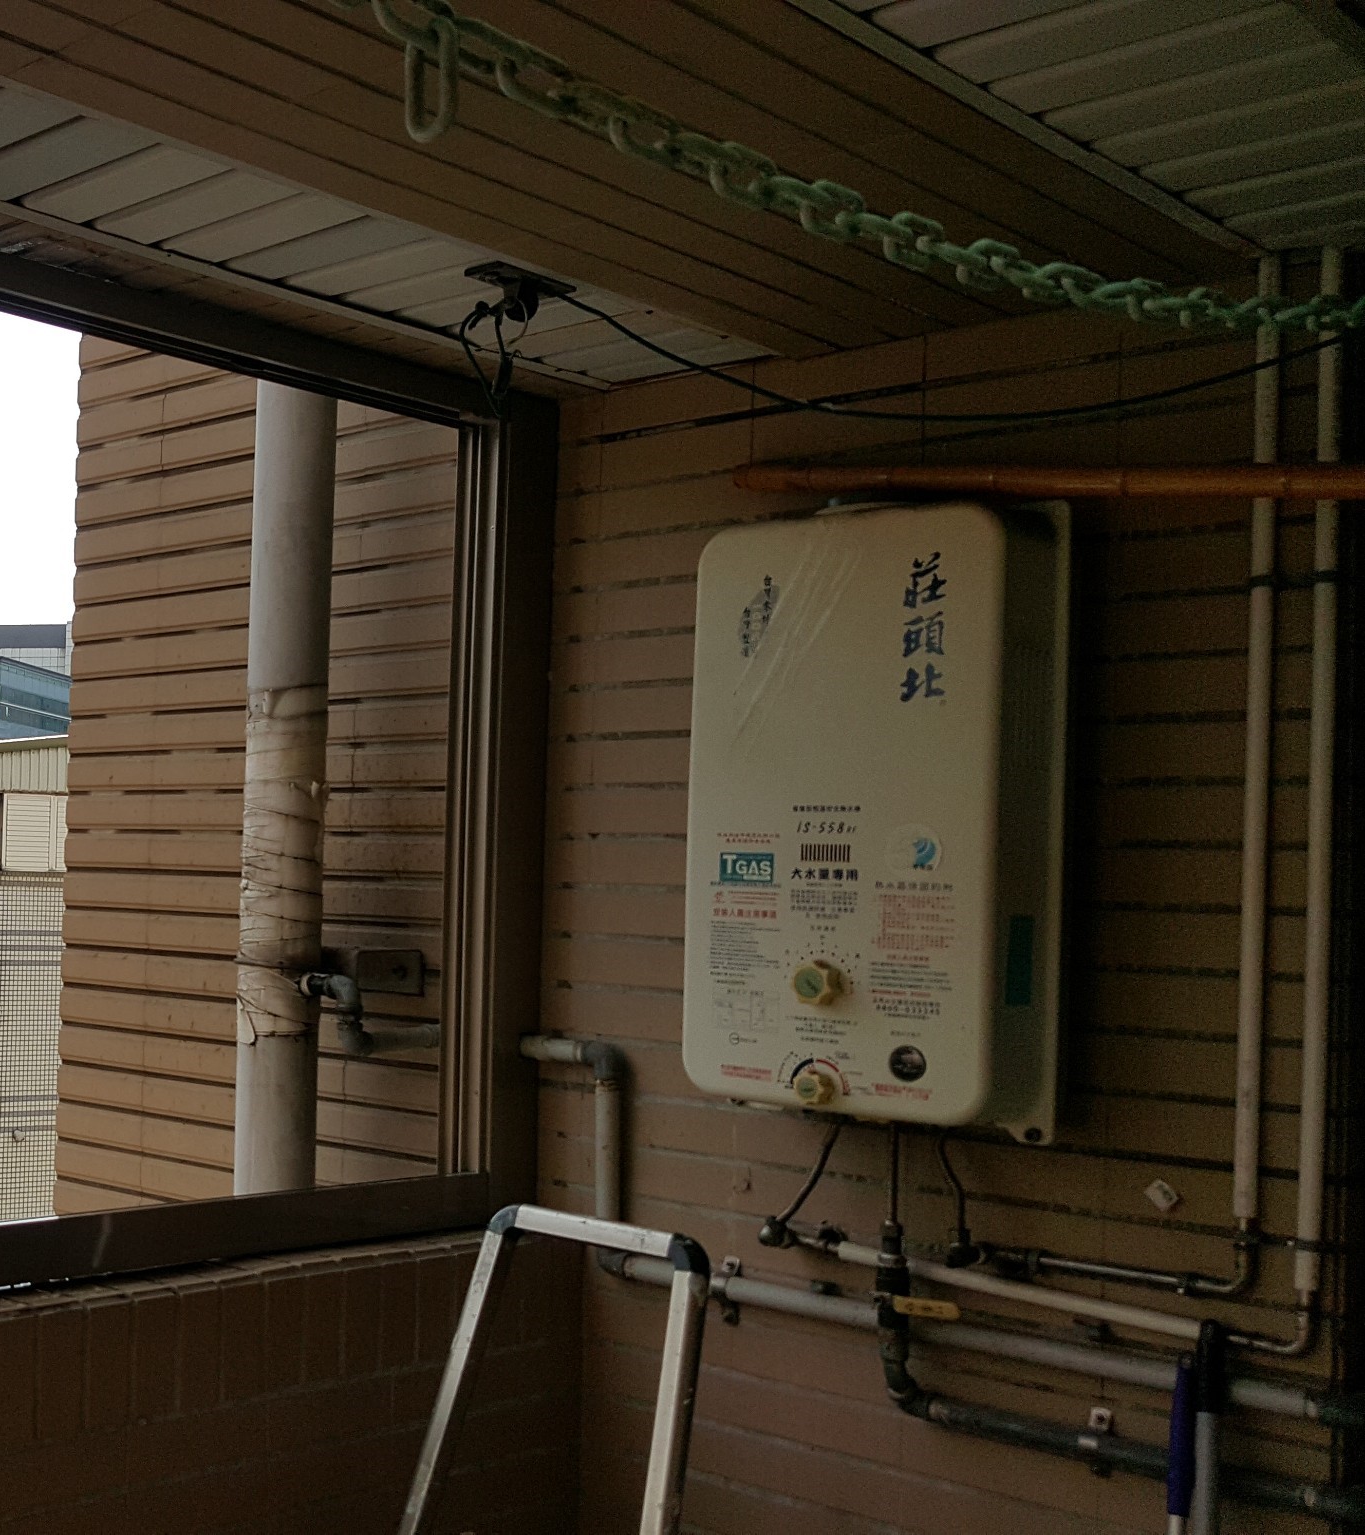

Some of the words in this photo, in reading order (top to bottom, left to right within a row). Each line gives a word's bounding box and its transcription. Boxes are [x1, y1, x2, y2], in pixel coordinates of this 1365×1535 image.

[900, 551, 947, 702] 莊頭北
[722, 854, 772, 875] TGAS
